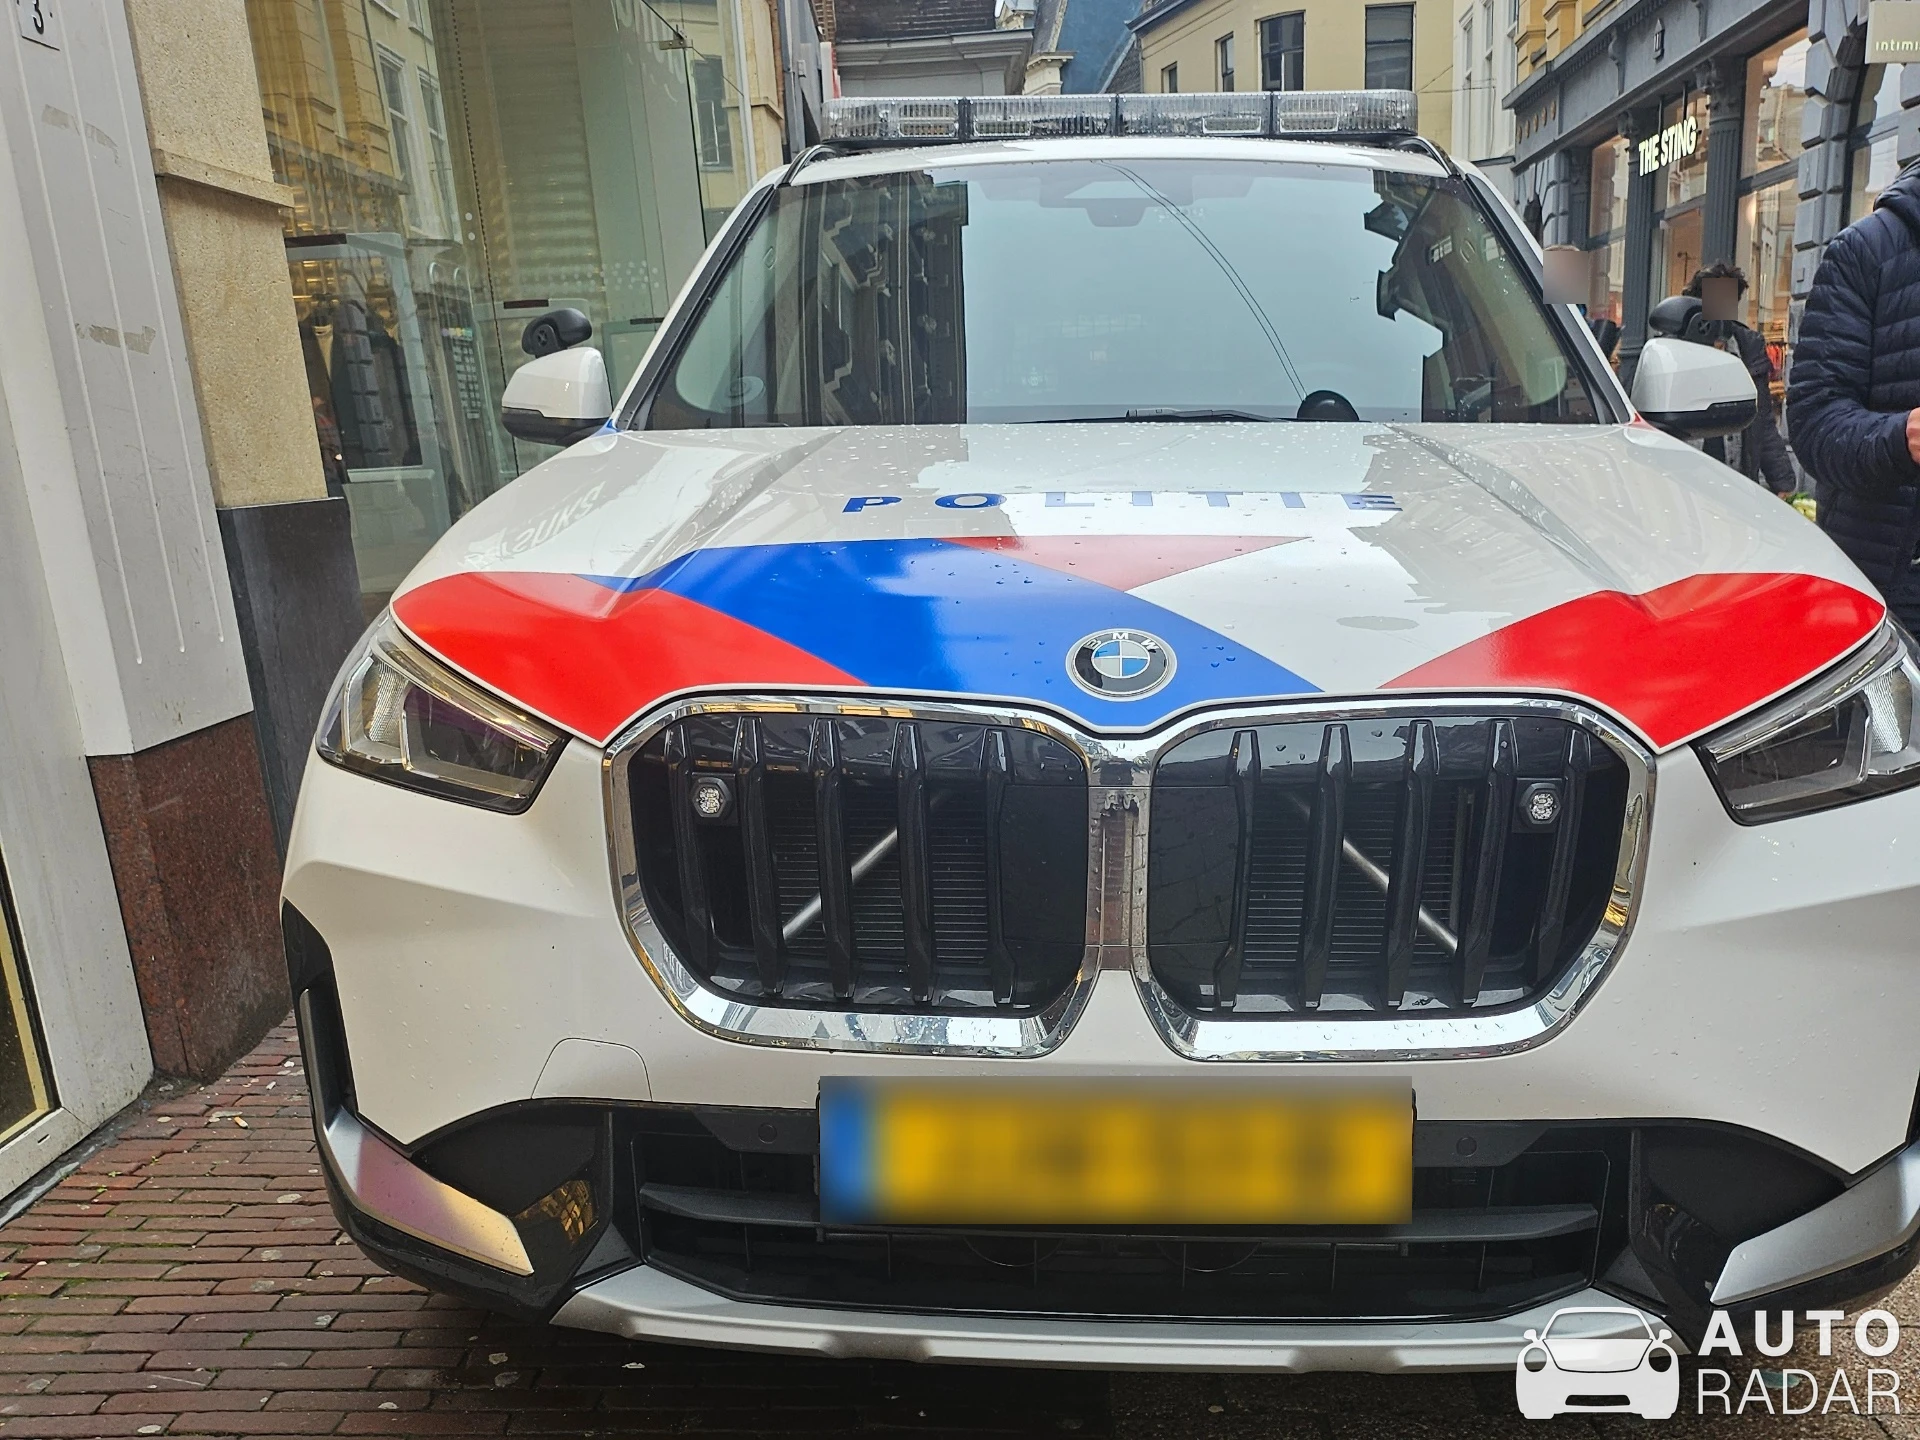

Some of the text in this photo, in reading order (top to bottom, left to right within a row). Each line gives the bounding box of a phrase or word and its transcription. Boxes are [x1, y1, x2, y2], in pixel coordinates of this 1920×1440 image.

[1875, 39, 1920, 51] intimi
[1638, 115, 1697, 177] THE STING
[842, 490, 1404, 513] POLITIE
